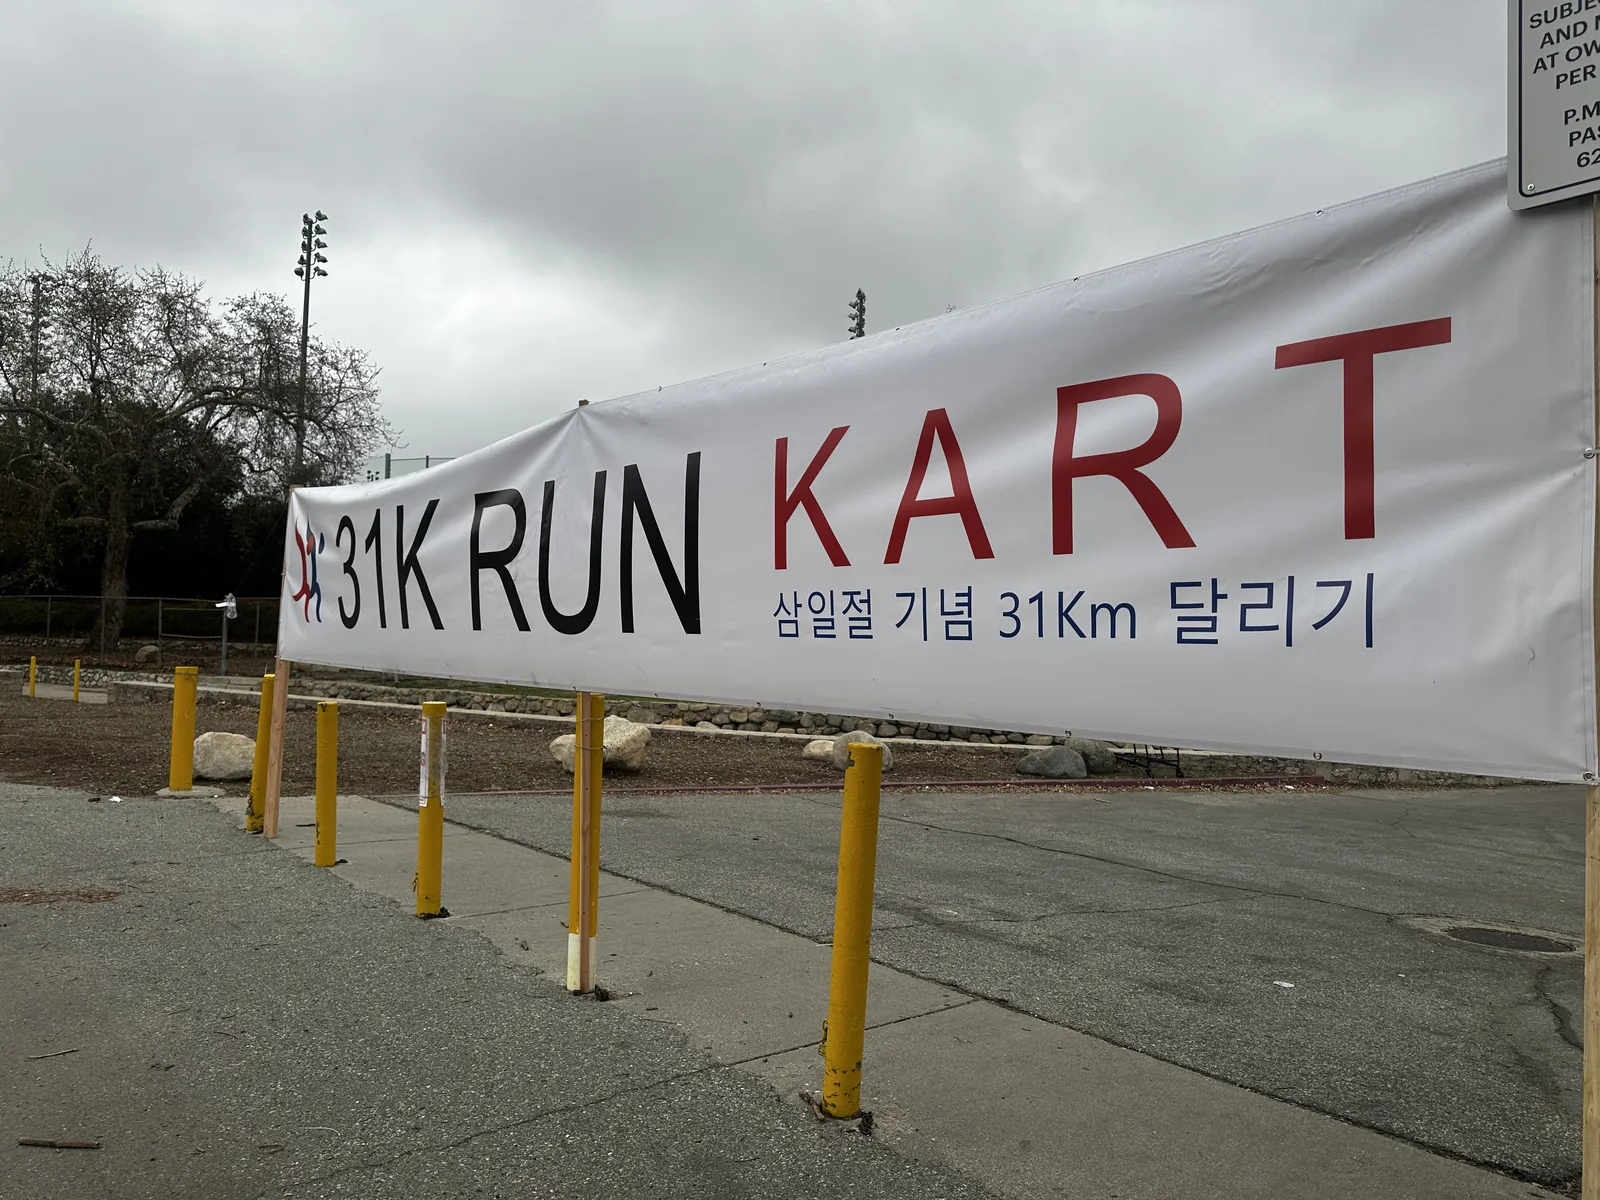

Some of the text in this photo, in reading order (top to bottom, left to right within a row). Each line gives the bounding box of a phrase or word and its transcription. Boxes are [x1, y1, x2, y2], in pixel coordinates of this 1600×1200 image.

[1529, 0, 1600, 29] SUBJE
[1540, 21, 1588, 49] AND
[1533, 52, 1559, 75] AT
[1556, 64, 1597, 90] PER
[1569, 125, 1600, 148] PA
[774, 317, 1451, 570] KART
[336, 452, 701, 635] 31K RUN
[773, 573, 1374, 648] 삼일절 기념 31Km 달리기
